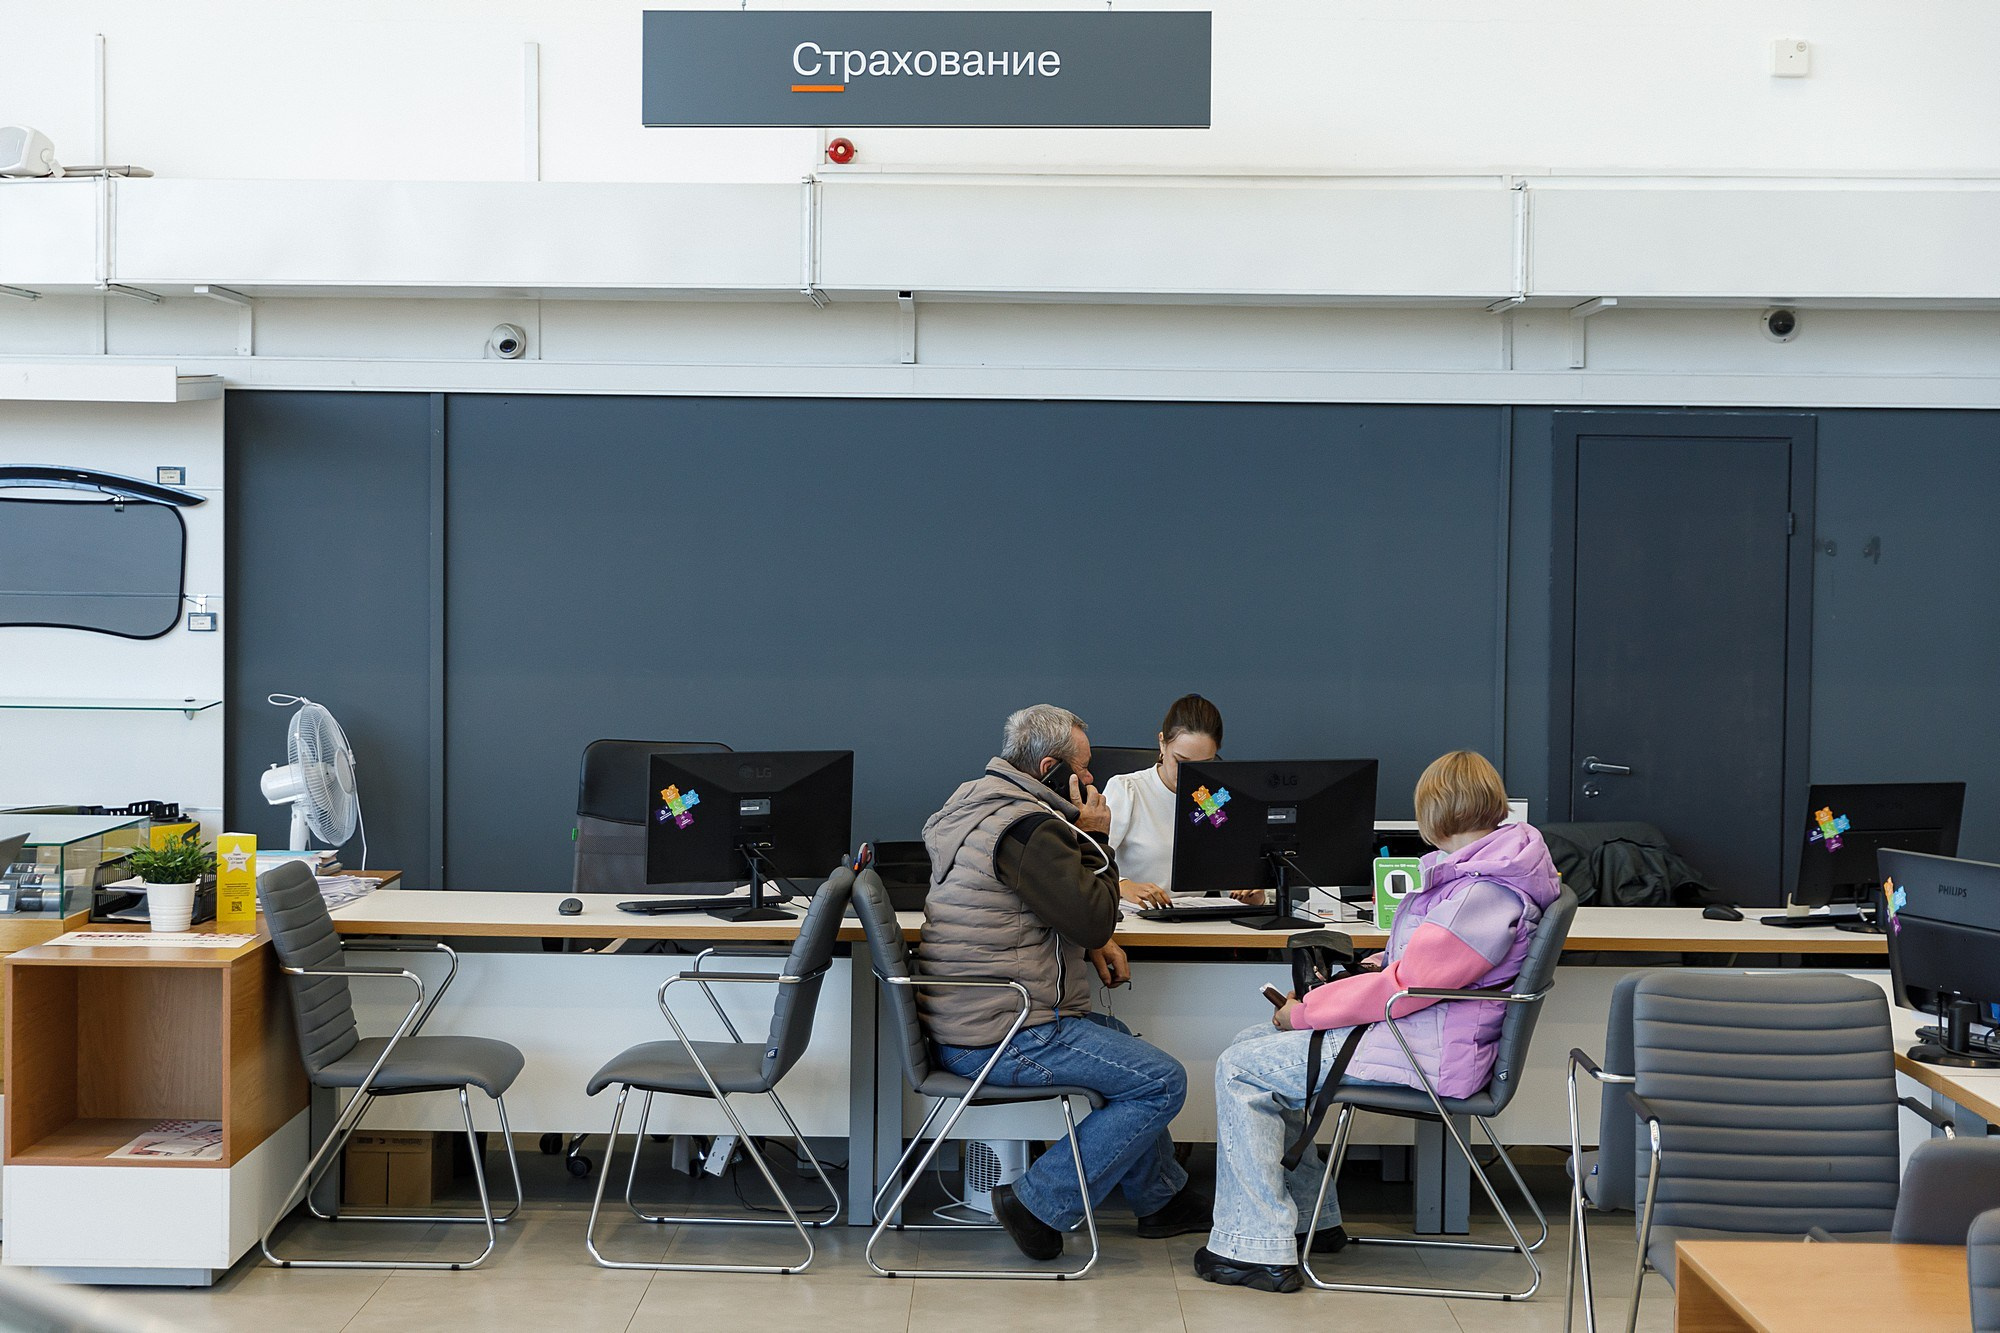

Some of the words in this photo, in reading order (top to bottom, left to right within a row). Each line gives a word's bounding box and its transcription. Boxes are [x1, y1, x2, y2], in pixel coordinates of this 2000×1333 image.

[793, 42, 1061, 83] Страхование
[756, 768, 771, 778] LG
[1283, 775, 1297, 786] LG
[1938, 884, 1967, 898] PHILIPS
